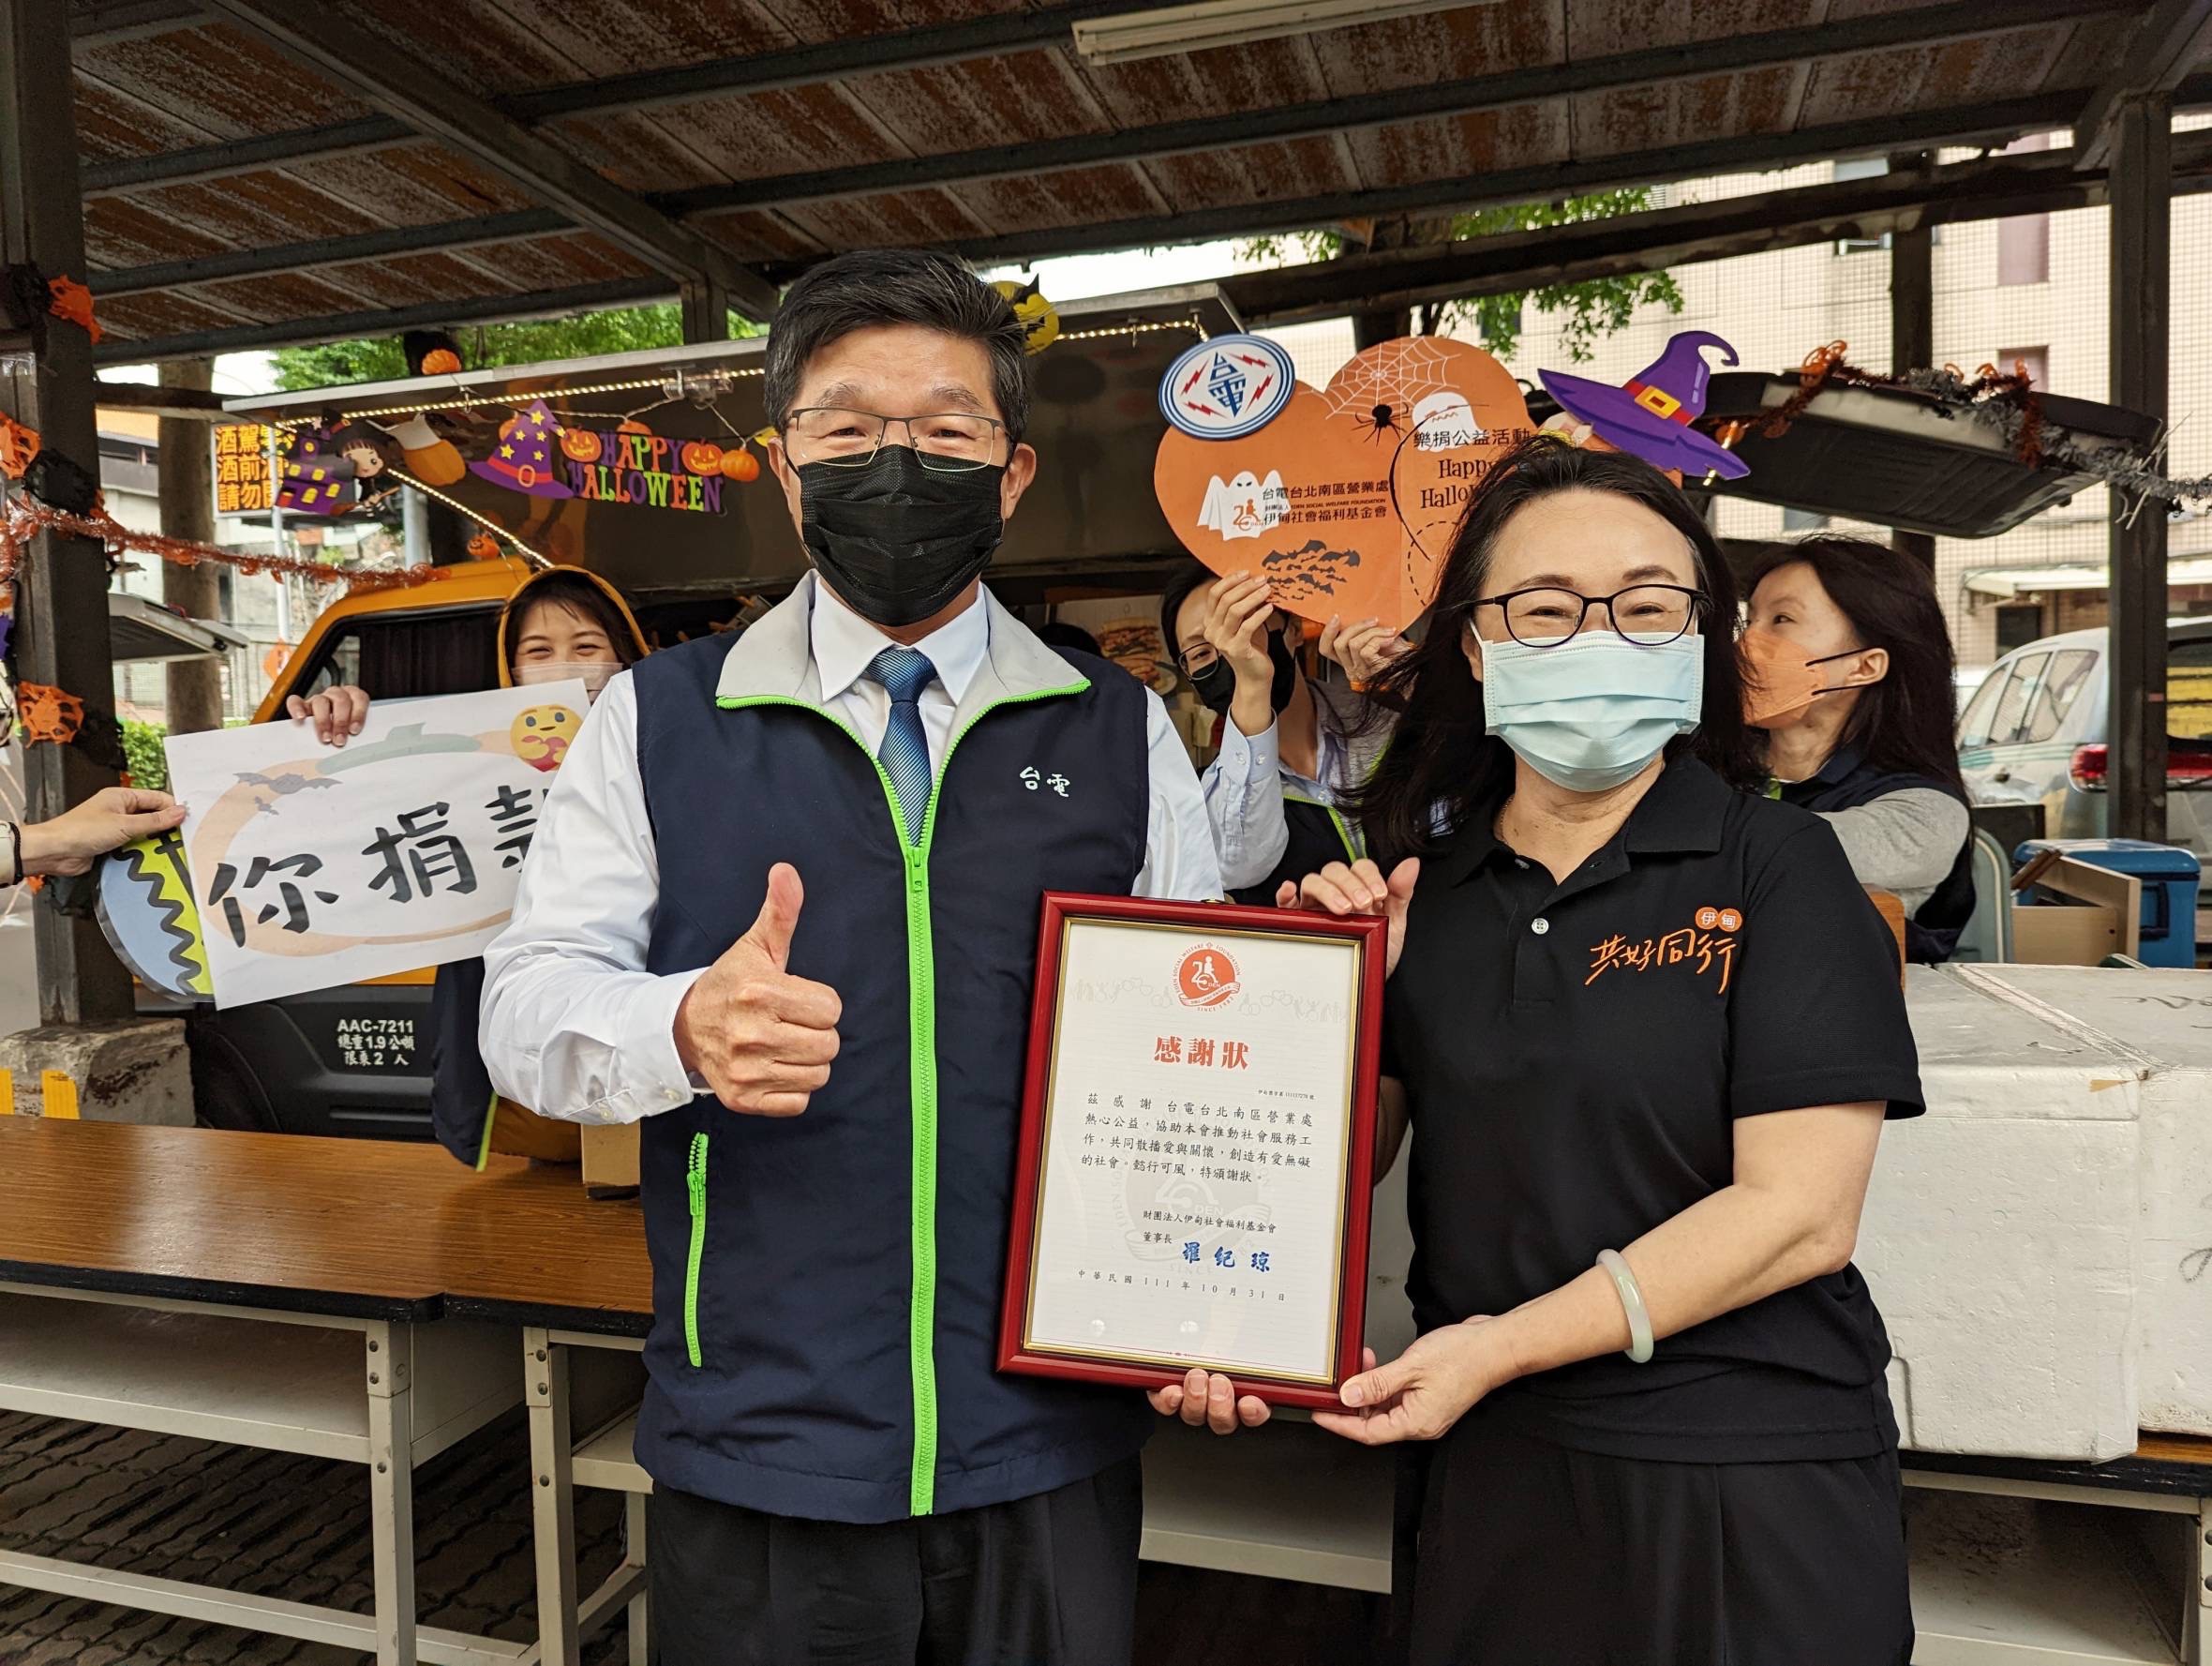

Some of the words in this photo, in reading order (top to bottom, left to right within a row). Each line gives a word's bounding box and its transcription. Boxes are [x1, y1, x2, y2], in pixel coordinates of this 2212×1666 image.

[1413, 428, 1530, 448] 樂捐公益活動
[600, 432, 687, 473] HAPPY
[566, 461, 723, 513] HALLOWEEN
[1263, 479, 1389, 501] 台電台北南區營業處
[1420, 484, 1476, 509] Hallo
[1263, 505, 1387, 526] 伊甸社會福利基金會
[1020, 766, 1070, 797] 台電
[1701, 911, 1736, 927] 伊甸
[1585, 928, 1737, 995] 共好同行
[337, 1019, 413, 1033] AAC-7211
[1154, 1035, 1251, 1072] 感謝狀
[1143, 1209, 1277, 1234] 財團法人伊甸社會福利基金會
[1143, 1231, 1173, 1244] 董事長
